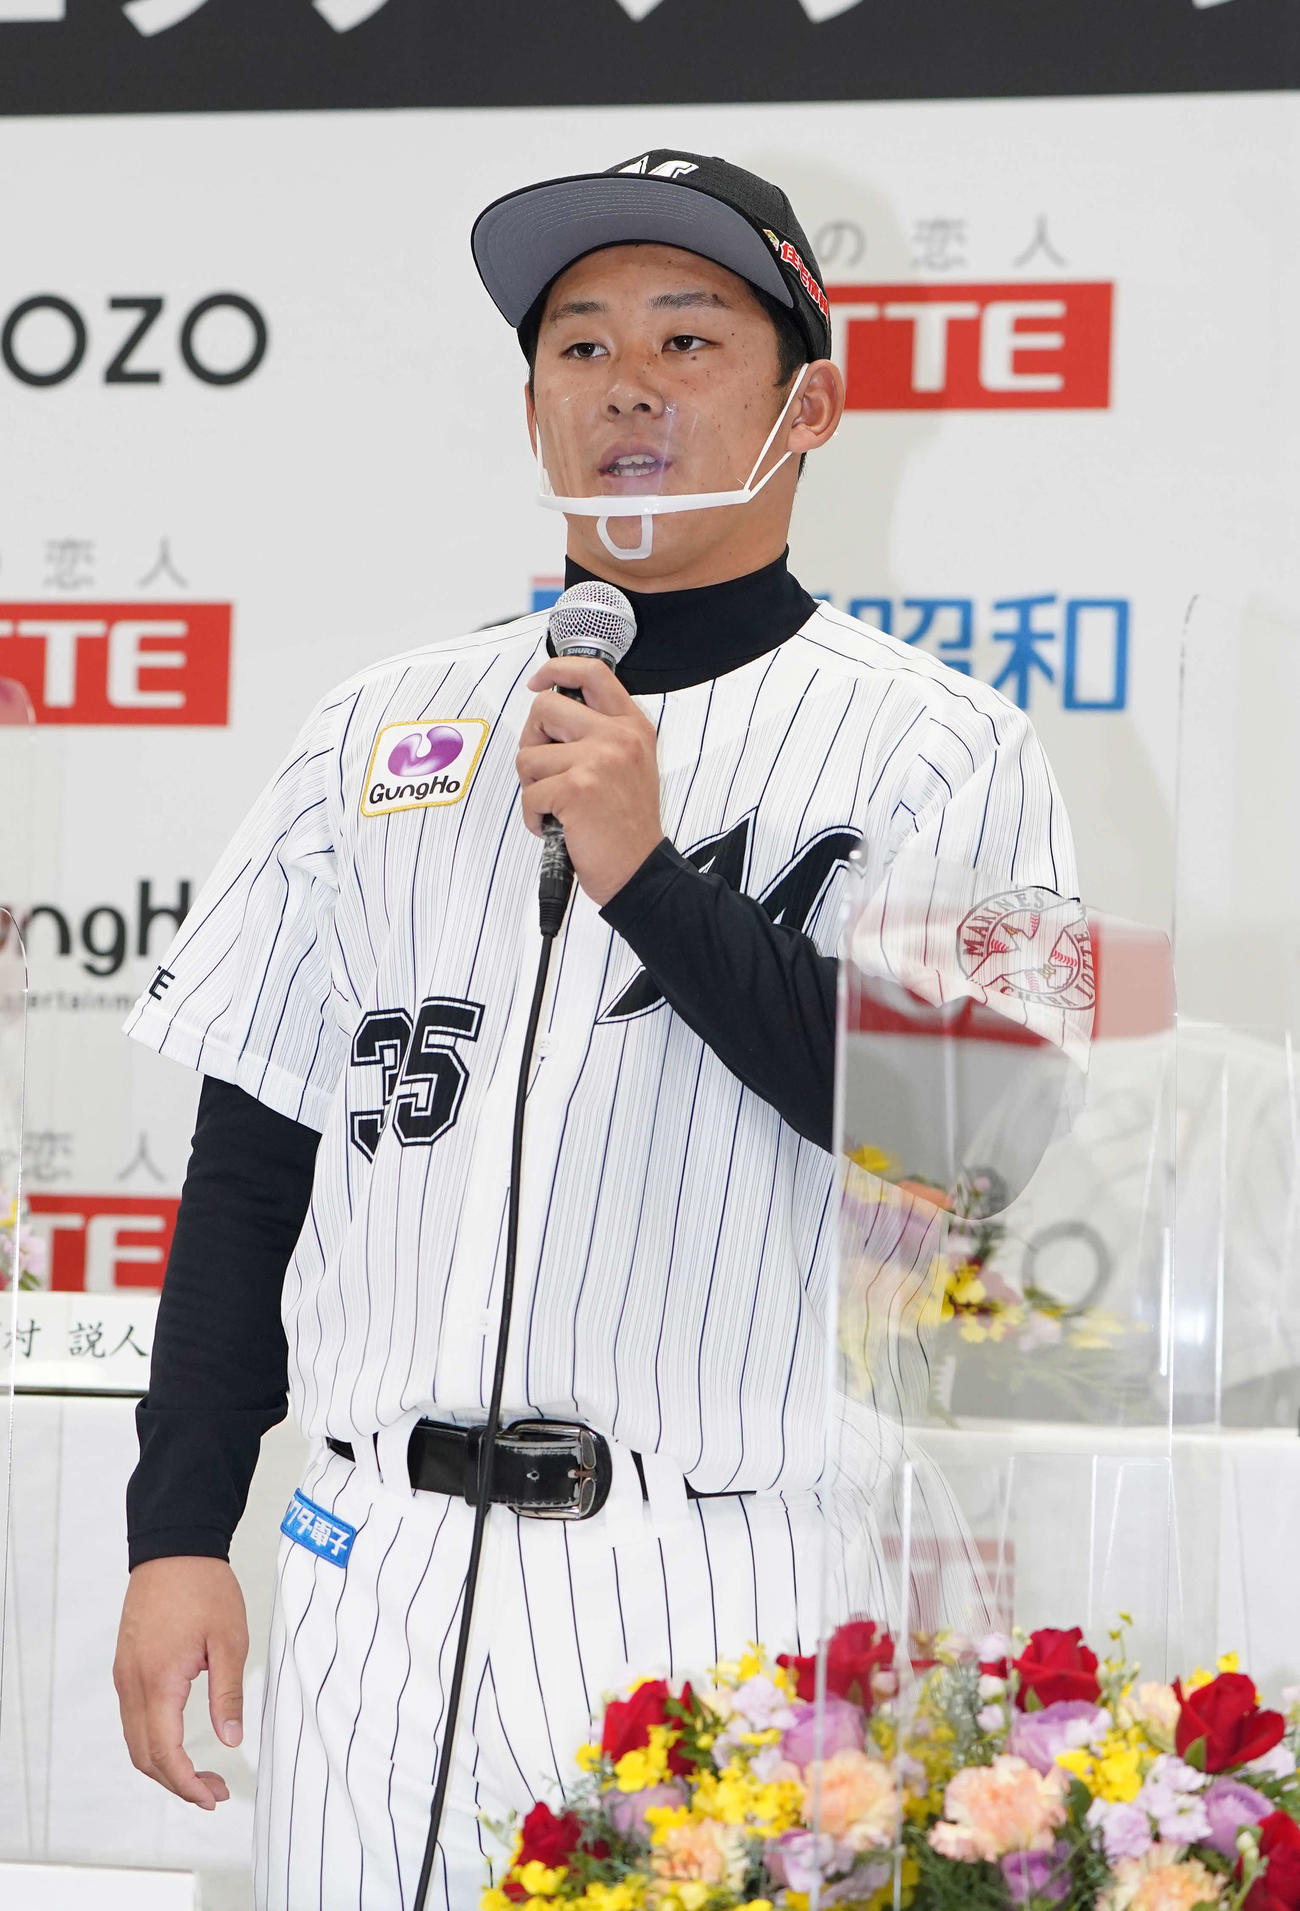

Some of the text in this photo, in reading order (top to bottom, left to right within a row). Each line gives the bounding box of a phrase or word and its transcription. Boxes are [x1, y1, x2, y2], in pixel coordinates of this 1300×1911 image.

[780, 240, 829, 325] 住宅情報
[0, 535, 189, 592] 恋人
[0, 619, 186, 709] TE
[567, 647, 597, 656] SHURE
[810, 592, 1130, 712] 昭和
[369, 775, 460, 804] GungHo
[0, 879, 191, 977] ngH
[963, 890, 1045, 957] MARINES
[149, 965, 176, 1001] E
[350, 996, 486, 1165] 35
